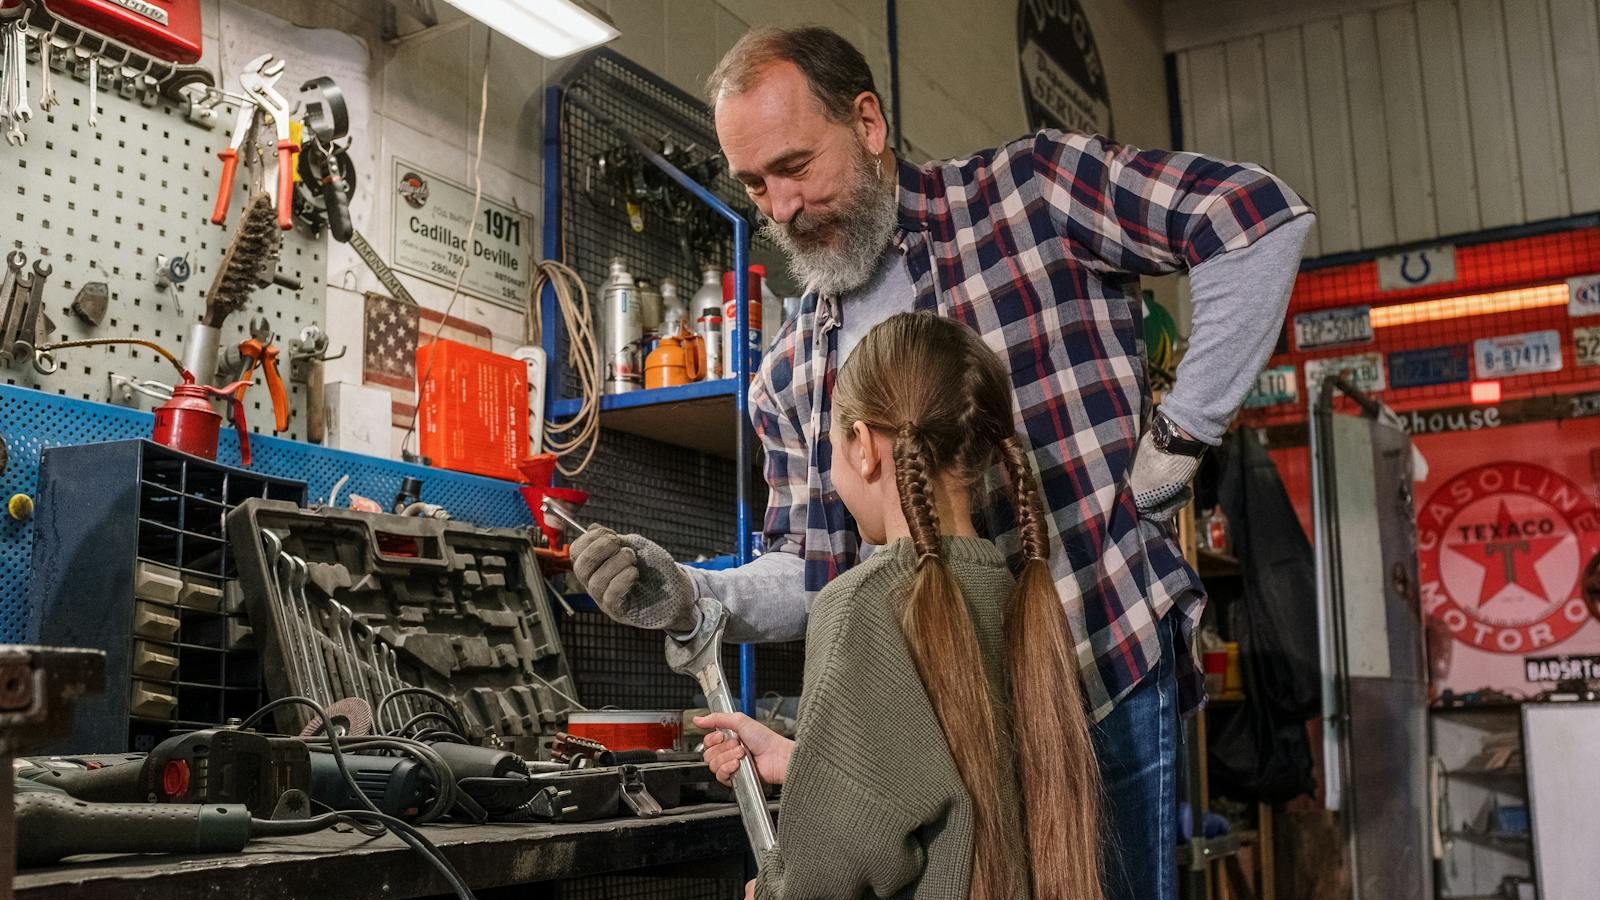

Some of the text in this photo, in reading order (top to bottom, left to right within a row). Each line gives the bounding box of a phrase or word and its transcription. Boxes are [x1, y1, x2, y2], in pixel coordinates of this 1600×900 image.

[409, 216, 468, 252] Cadillac
[473, 240, 518, 270] Deville
[484, 208, 520, 246] 1971
[1419, 468, 1598, 551] GASOLINE
[1459, 517, 1554, 542] TEXACO
[1421, 579, 1554, 652] MOTOR
